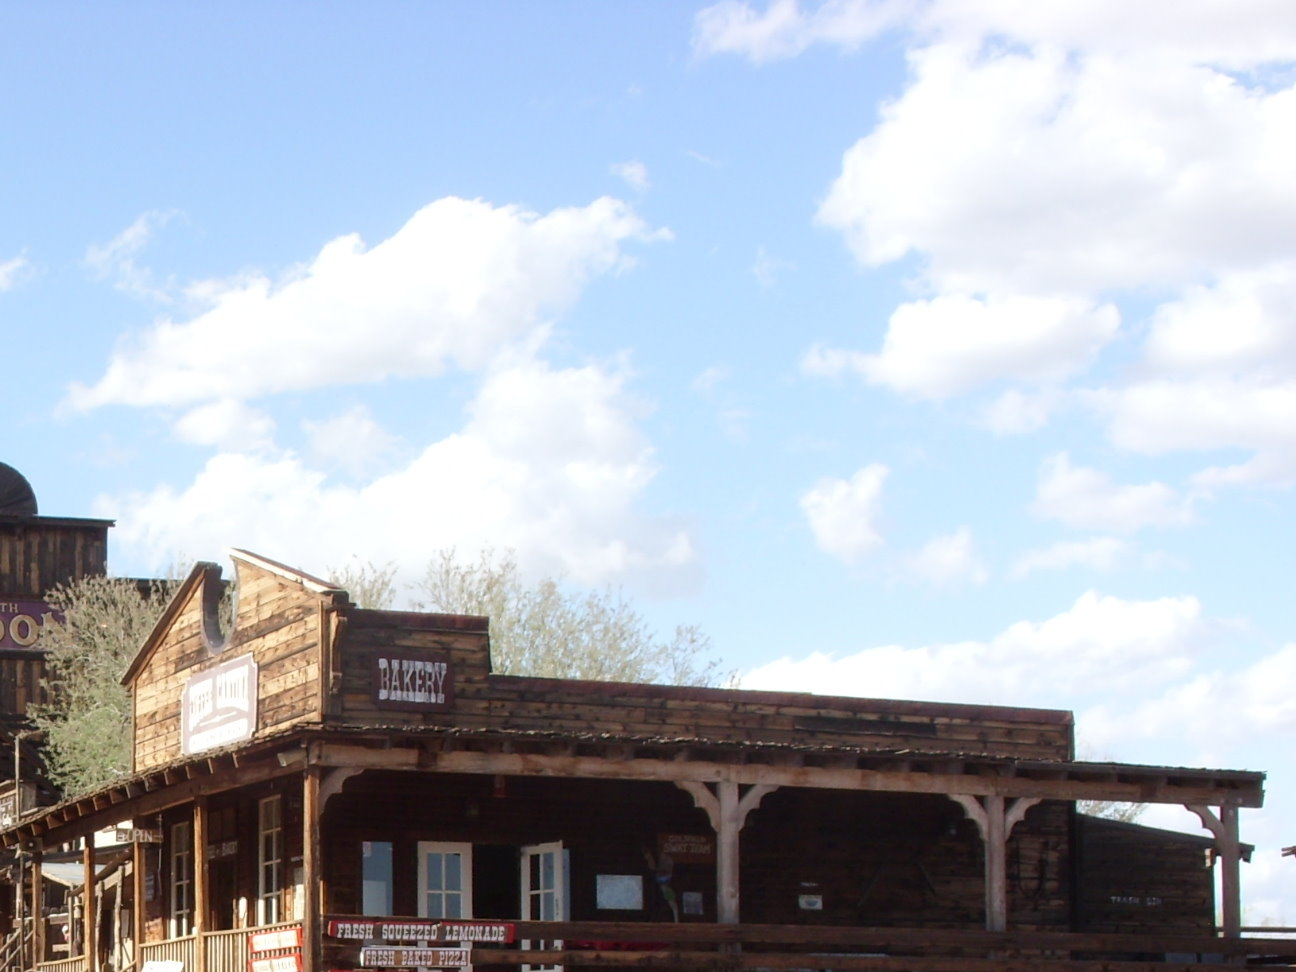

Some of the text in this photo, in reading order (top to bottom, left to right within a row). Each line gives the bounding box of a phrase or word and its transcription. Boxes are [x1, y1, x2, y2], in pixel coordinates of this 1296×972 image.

[378, 658, 447, 704] BAKERY
[126, 829, 153, 843] OPEN
[337, 923, 505, 941] FRESH SQUEEZED LEMONADE
[365, 950, 467, 967] FRESH BAKED PIZZA
